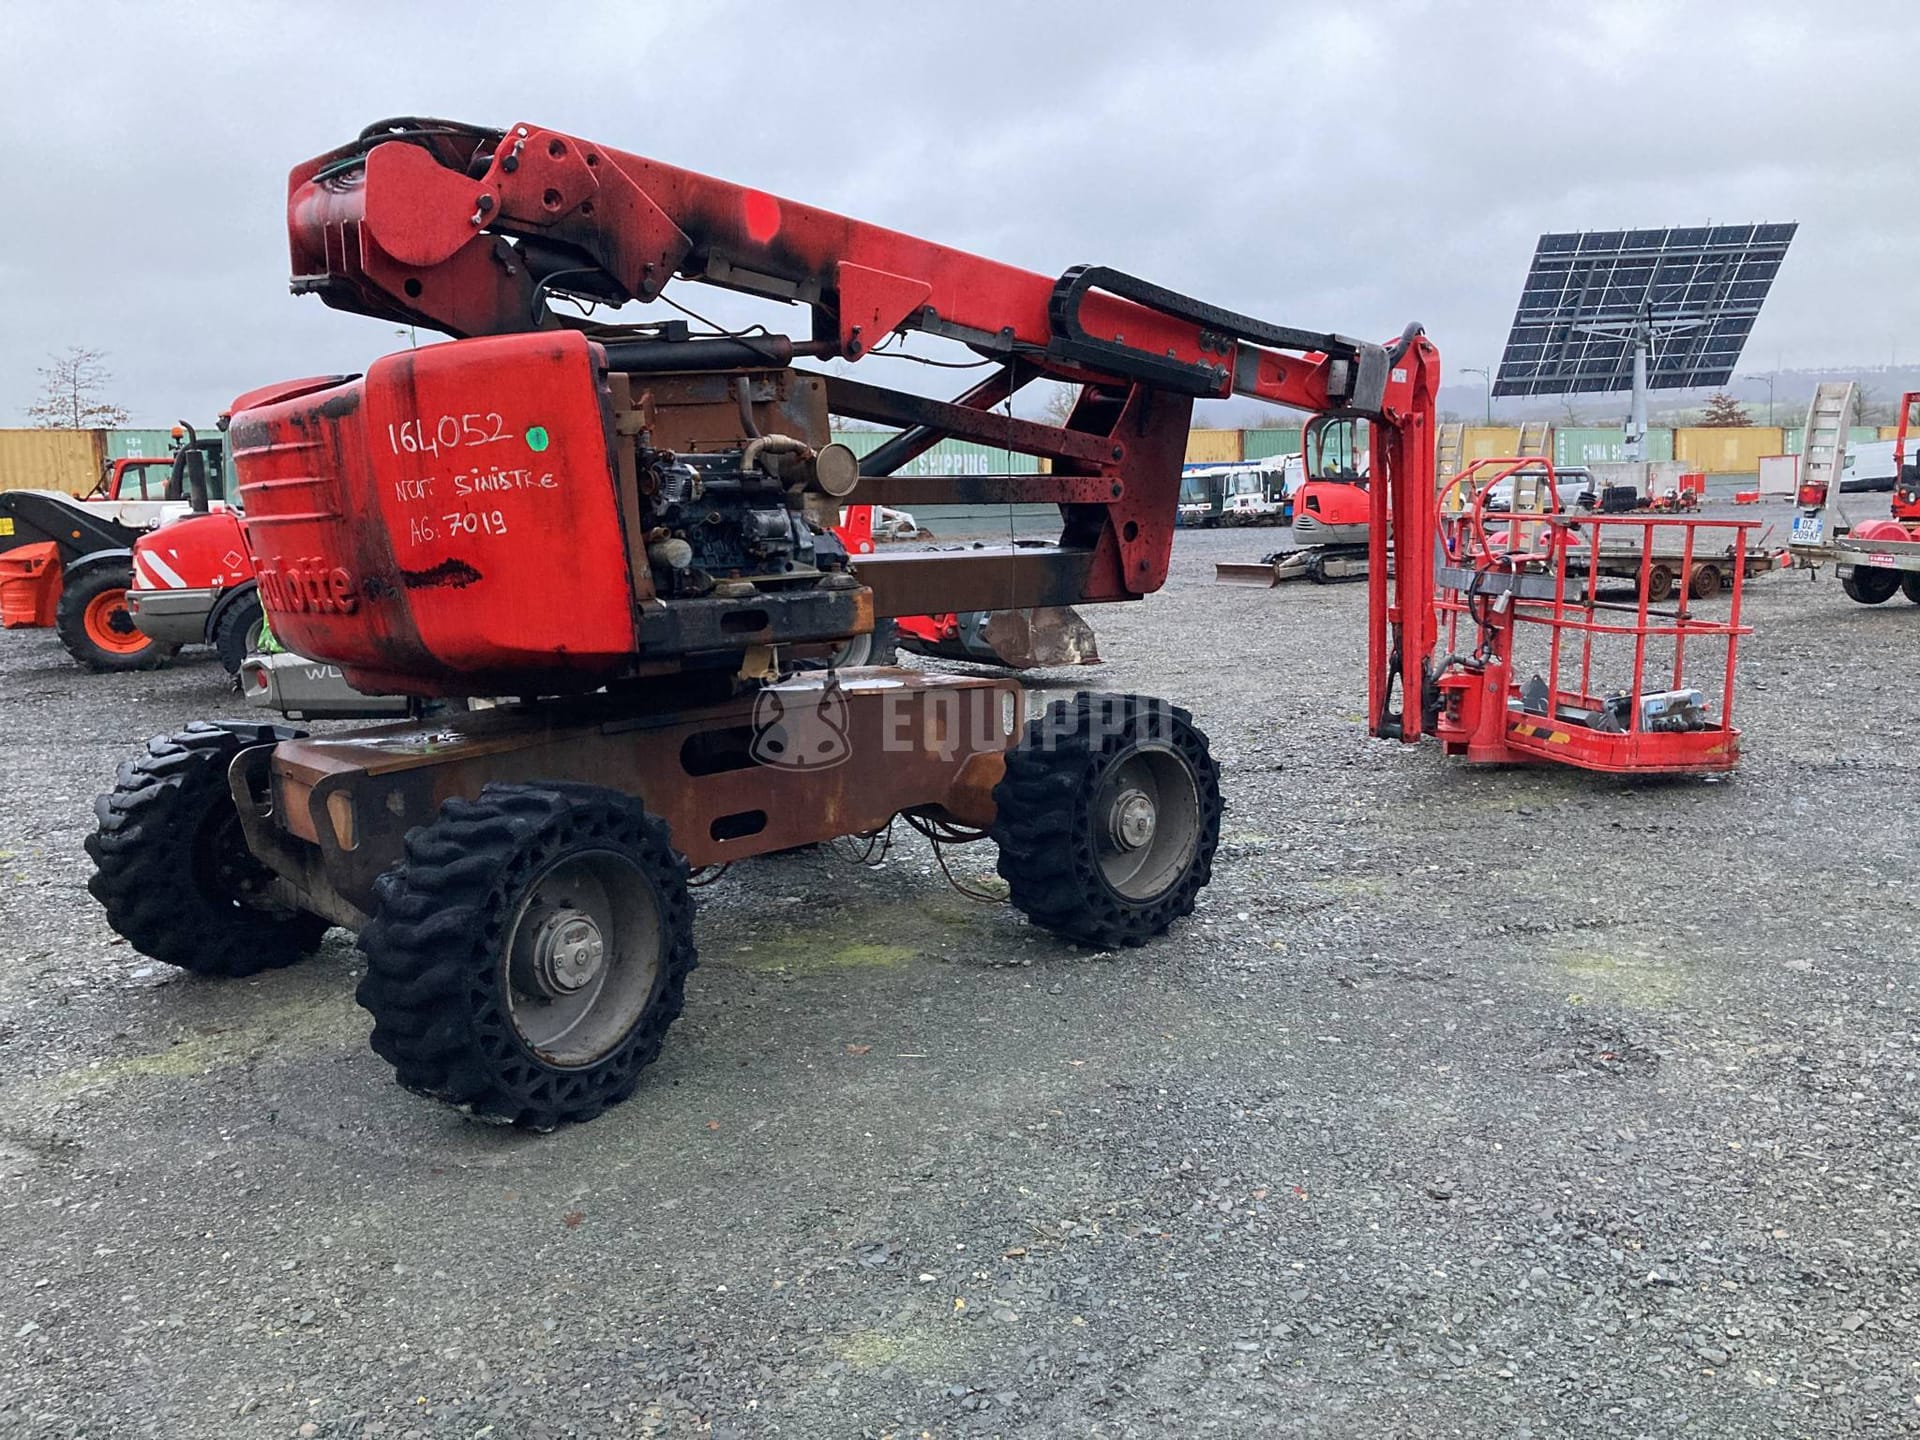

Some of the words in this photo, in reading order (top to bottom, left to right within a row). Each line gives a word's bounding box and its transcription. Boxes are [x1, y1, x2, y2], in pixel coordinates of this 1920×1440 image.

[388, 412, 514, 458] 164052
[1583, 443, 1608, 460] CHINA
[918, 453, 988, 475] SHIPPING
[442, 510, 507, 536] 7019
